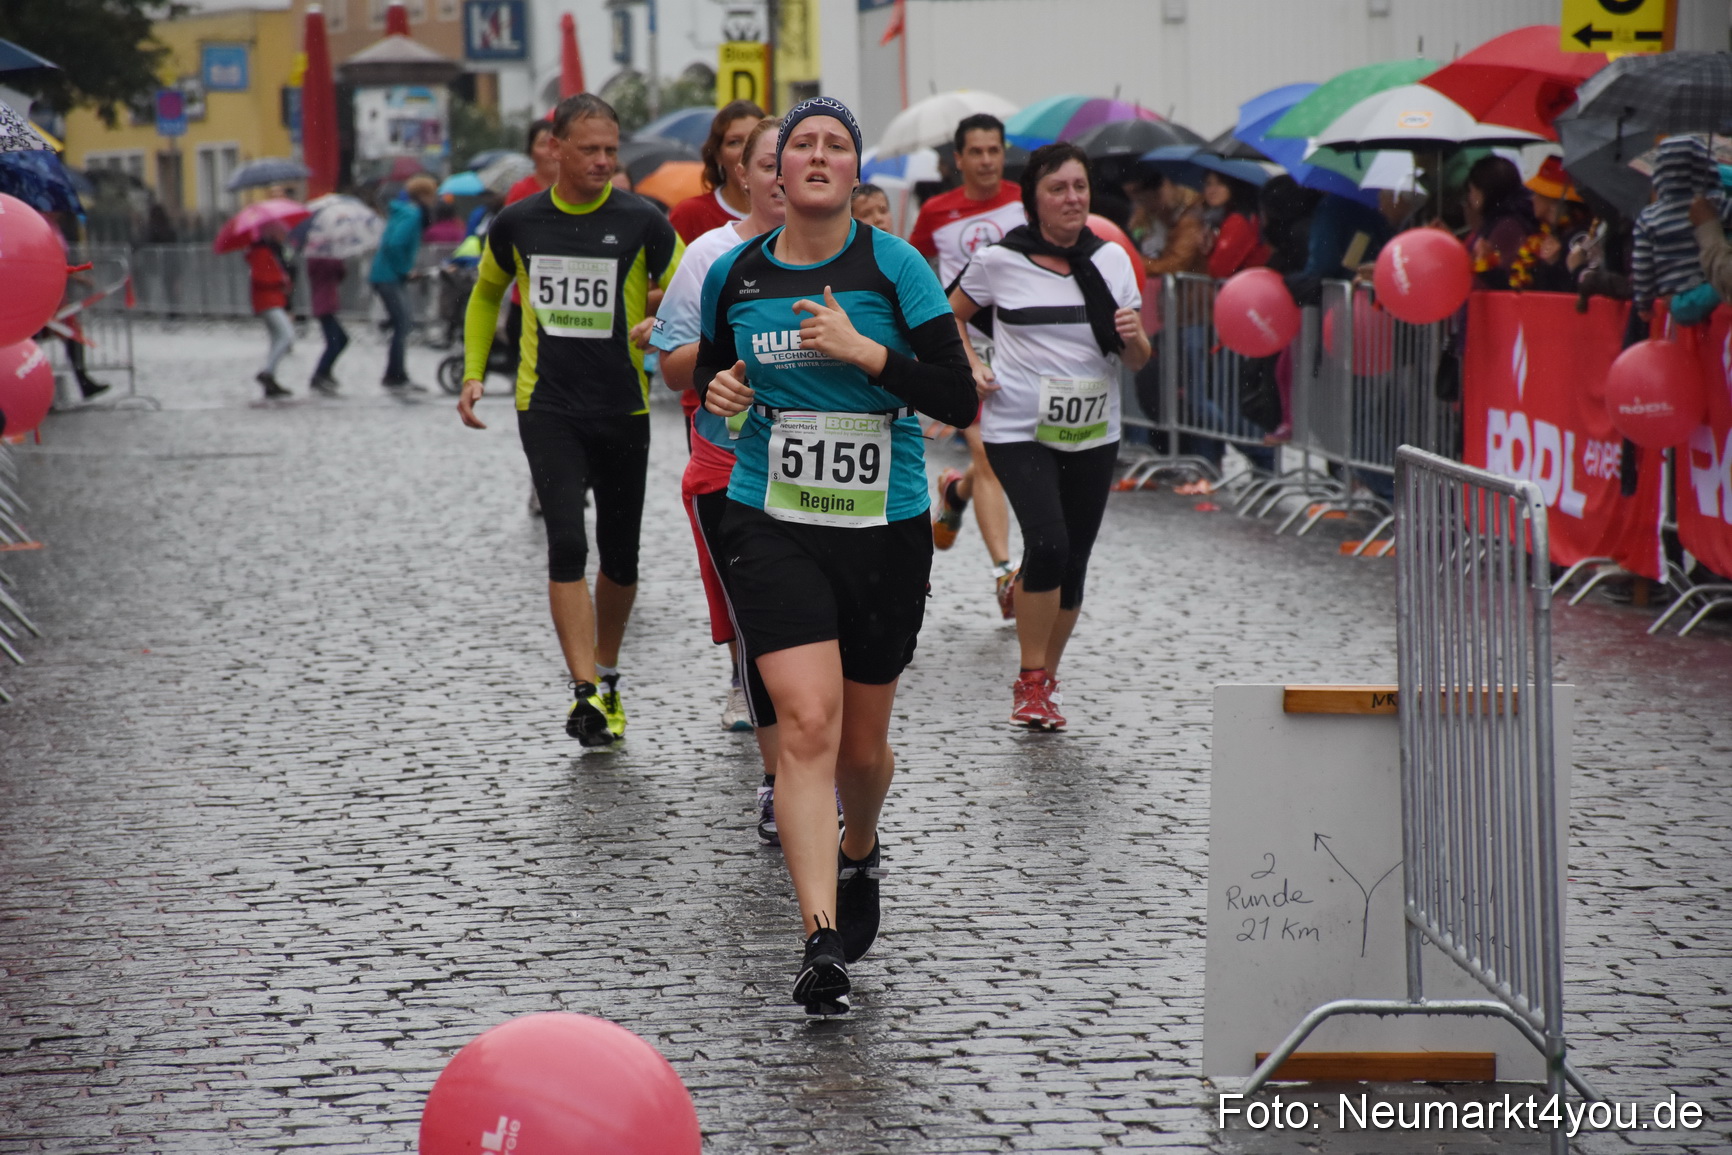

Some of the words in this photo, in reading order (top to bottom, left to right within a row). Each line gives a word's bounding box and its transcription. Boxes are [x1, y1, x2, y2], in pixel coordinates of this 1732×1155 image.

[732, 69, 756, 103] D
[539, 276, 608, 308] 5156
[739, 287, 760, 295] erima
[548, 312, 594, 327] Andreas
[1047, 392, 1108, 424] 5077
[825, 416, 881, 432] BOCK
[781, 438, 880, 484] 5159
[800, 491, 855, 513] Regina
[1251, 853, 1276, 879] 2
[1225, 878, 1314, 911] Runde
[1236, 916, 1270, 942] 21
